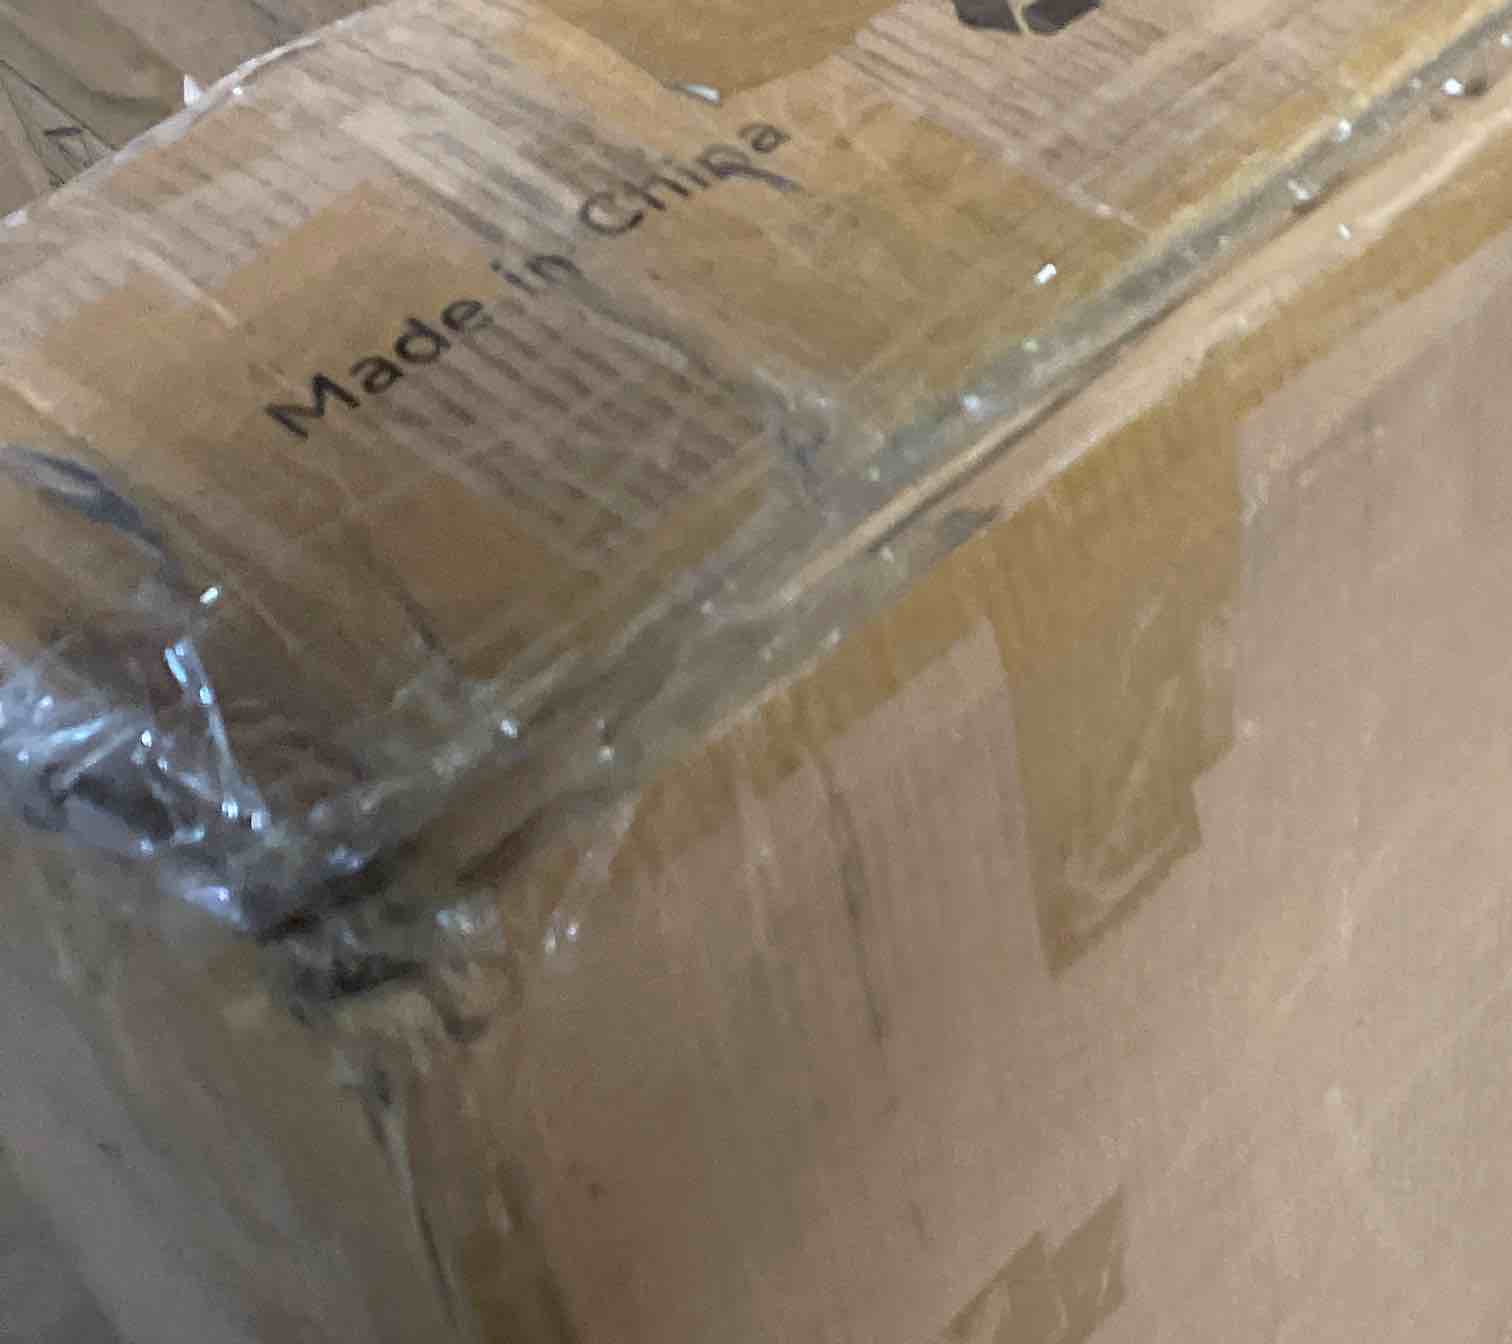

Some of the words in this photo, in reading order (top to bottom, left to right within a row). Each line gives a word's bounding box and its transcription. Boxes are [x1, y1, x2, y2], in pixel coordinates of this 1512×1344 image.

[265, 298, 486, 439] Made
[490, 253, 578, 297] in
[578, 122, 791, 236] China
